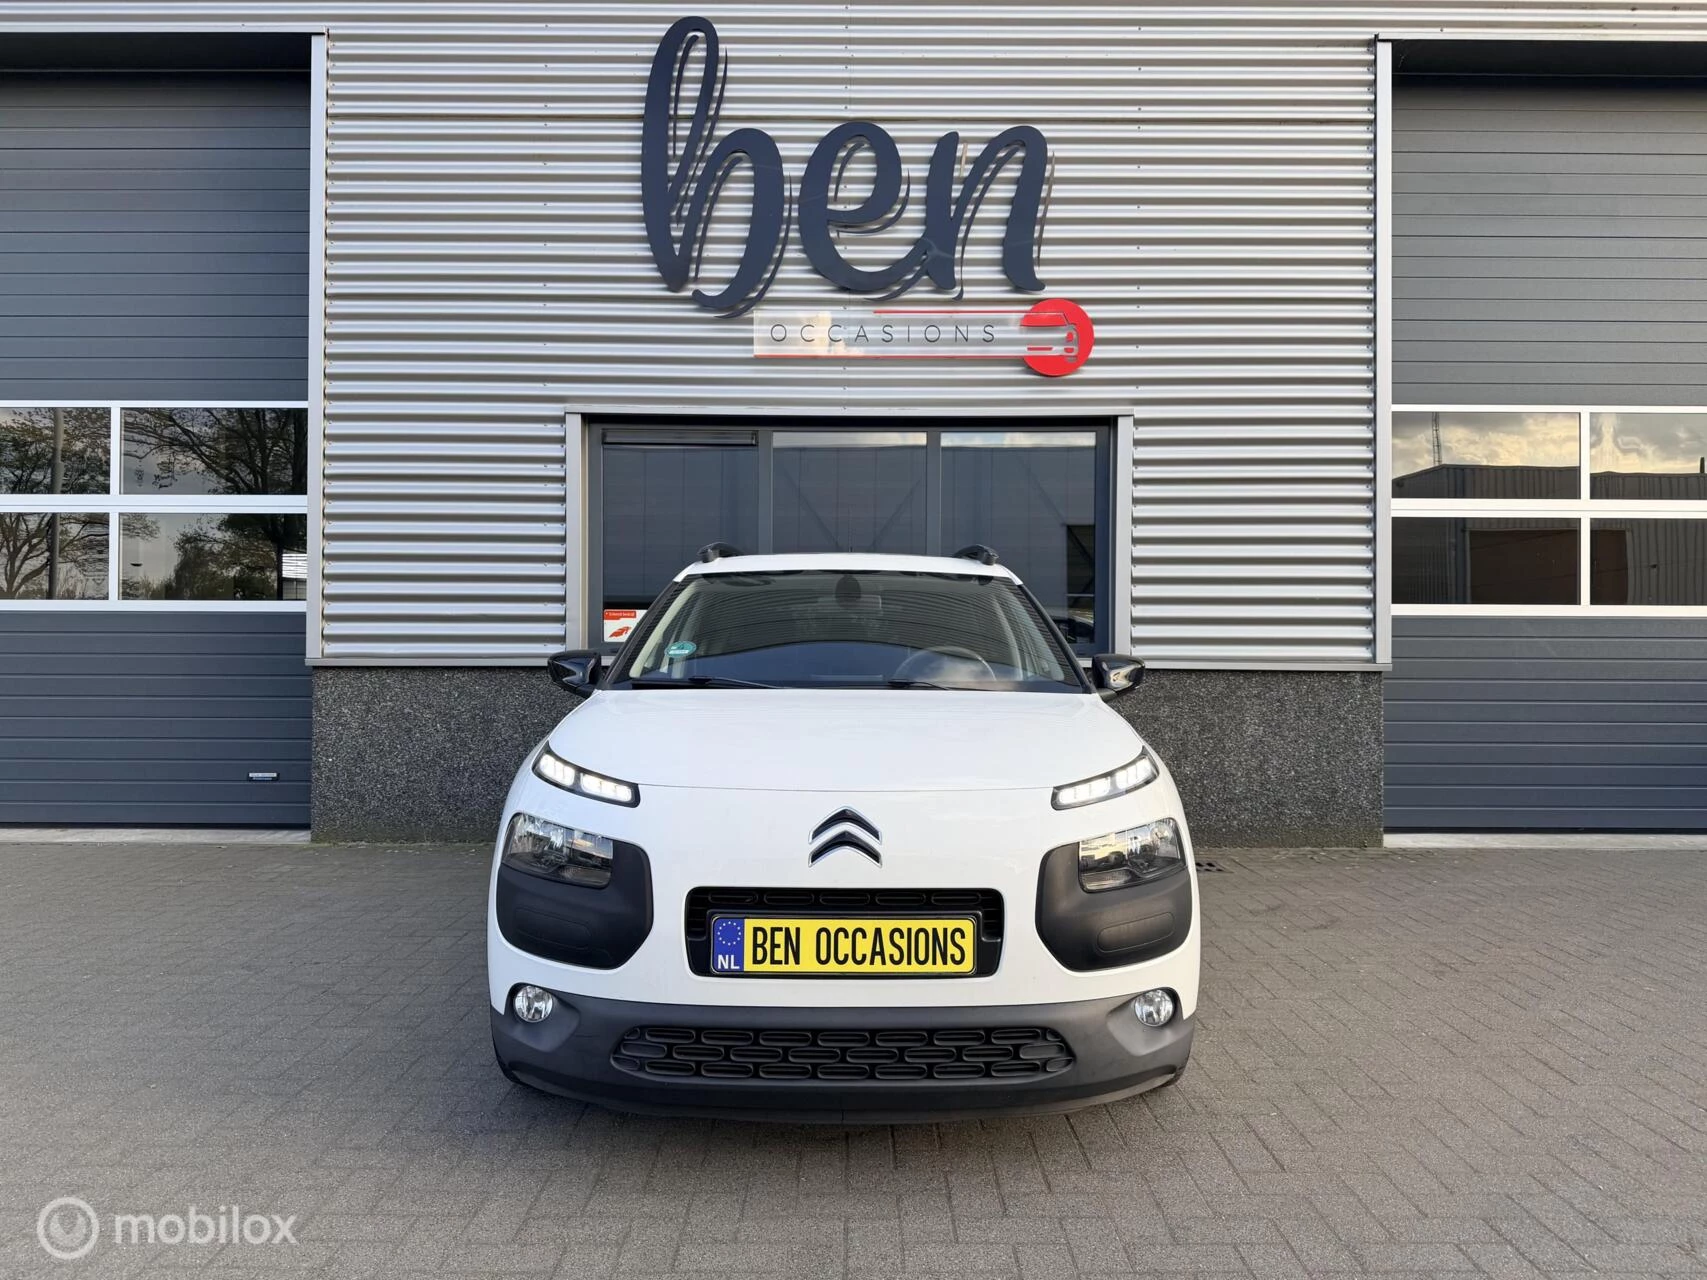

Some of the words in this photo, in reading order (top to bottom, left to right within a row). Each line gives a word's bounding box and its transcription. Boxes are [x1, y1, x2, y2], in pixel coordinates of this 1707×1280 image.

[641, 16, 1046, 310] ben
[770, 324, 995, 343] OCCASIONS
[752, 926, 801, 965] BEN
[815, 926, 966, 966] OCCASIONS
[717, 954, 740, 970] NL
